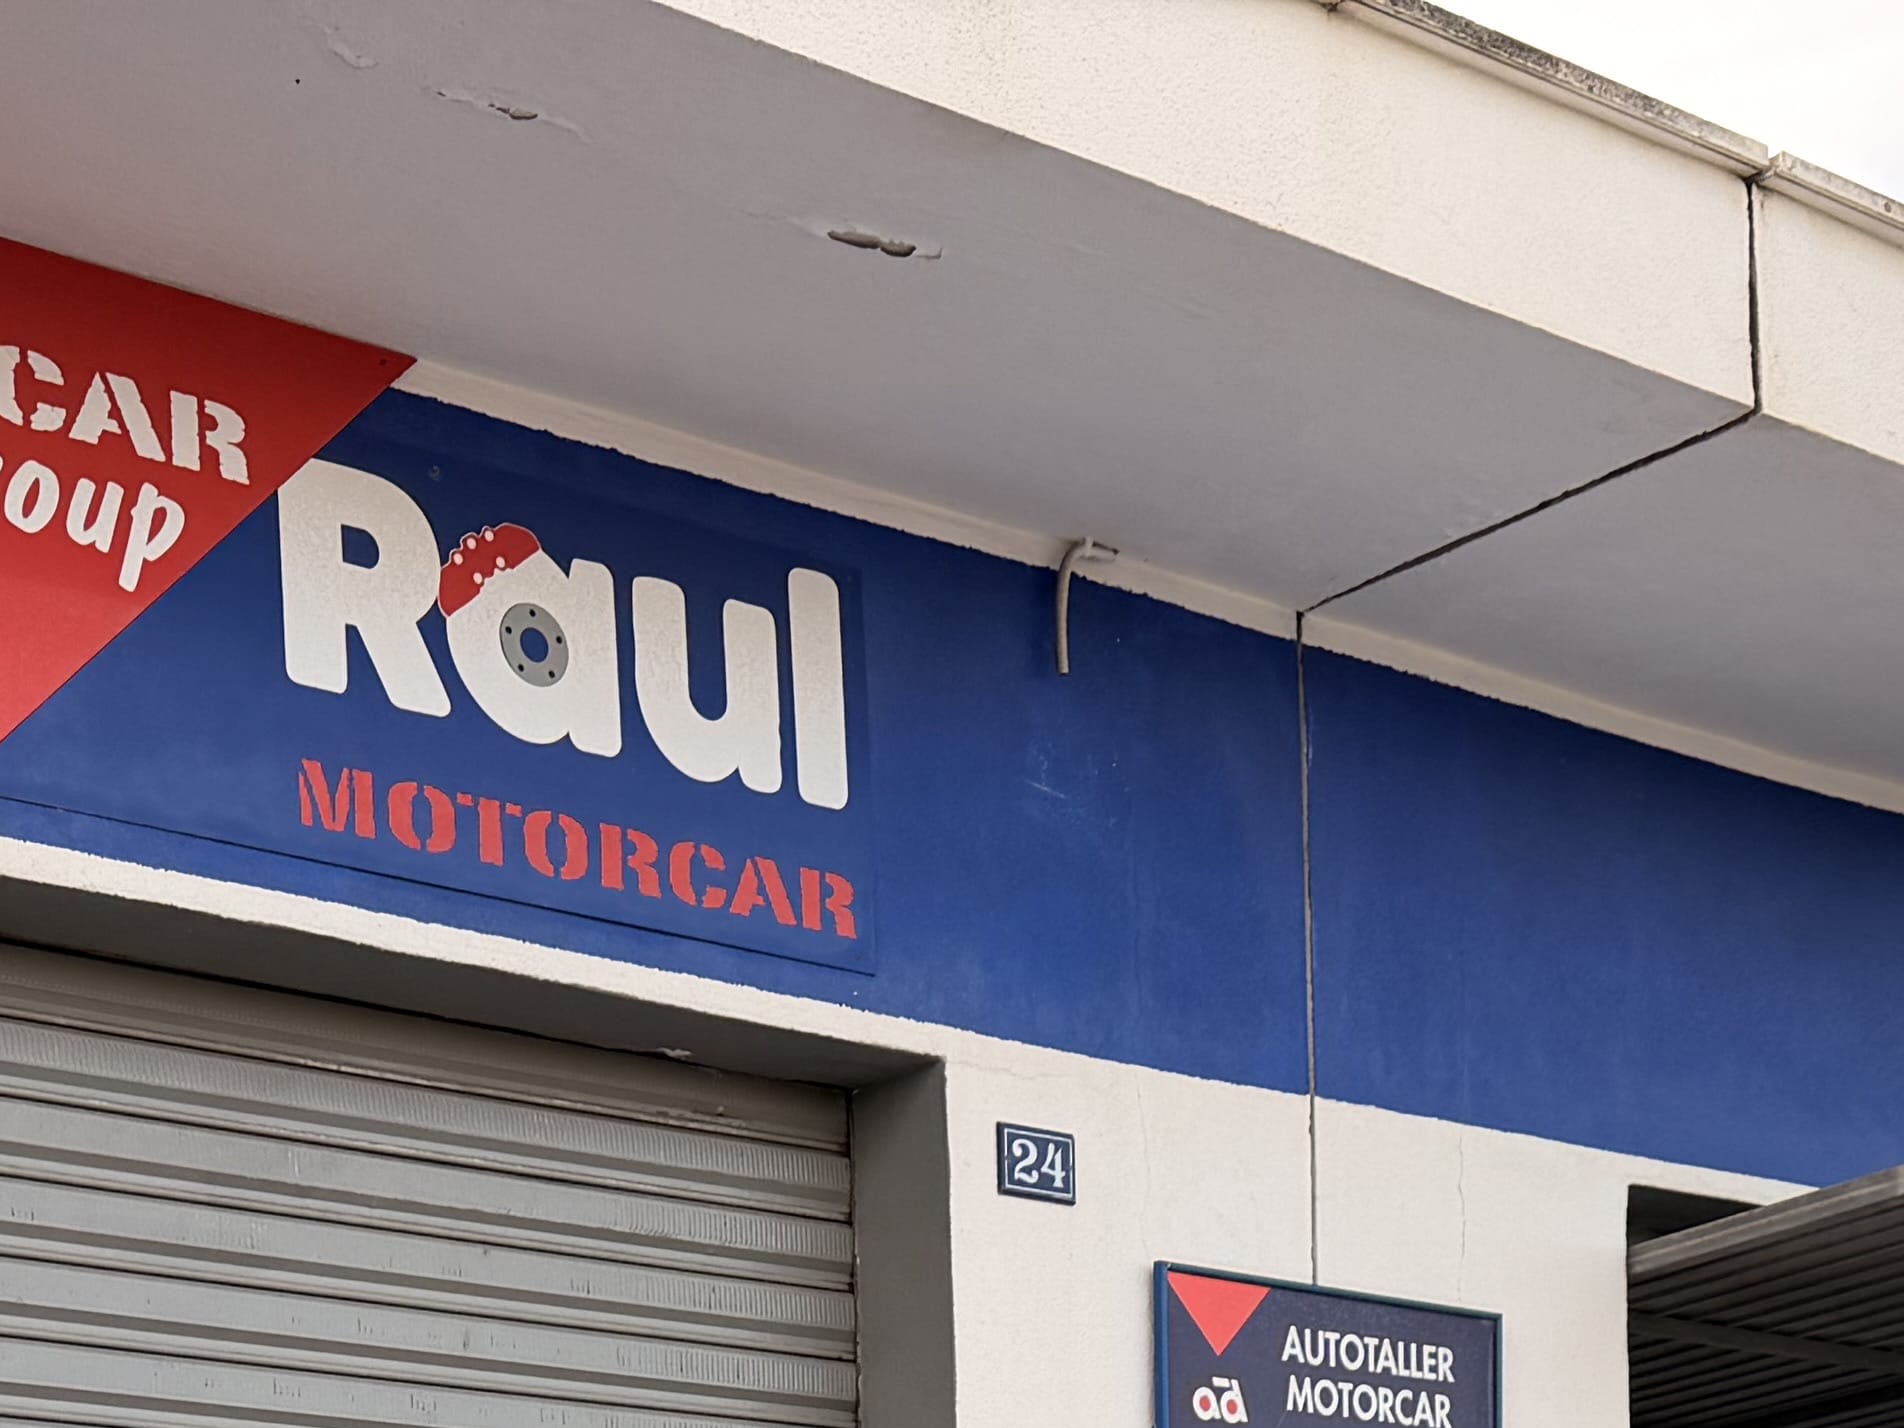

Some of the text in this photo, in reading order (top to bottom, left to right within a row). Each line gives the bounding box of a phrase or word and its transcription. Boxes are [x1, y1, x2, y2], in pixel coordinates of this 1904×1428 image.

[277, 457, 849, 809] Raul
[298, 757, 859, 940] MOTORCAR
[1011, 1137, 1066, 1190] 24
[1280, 1325, 1455, 1383] AUTOTALLER
